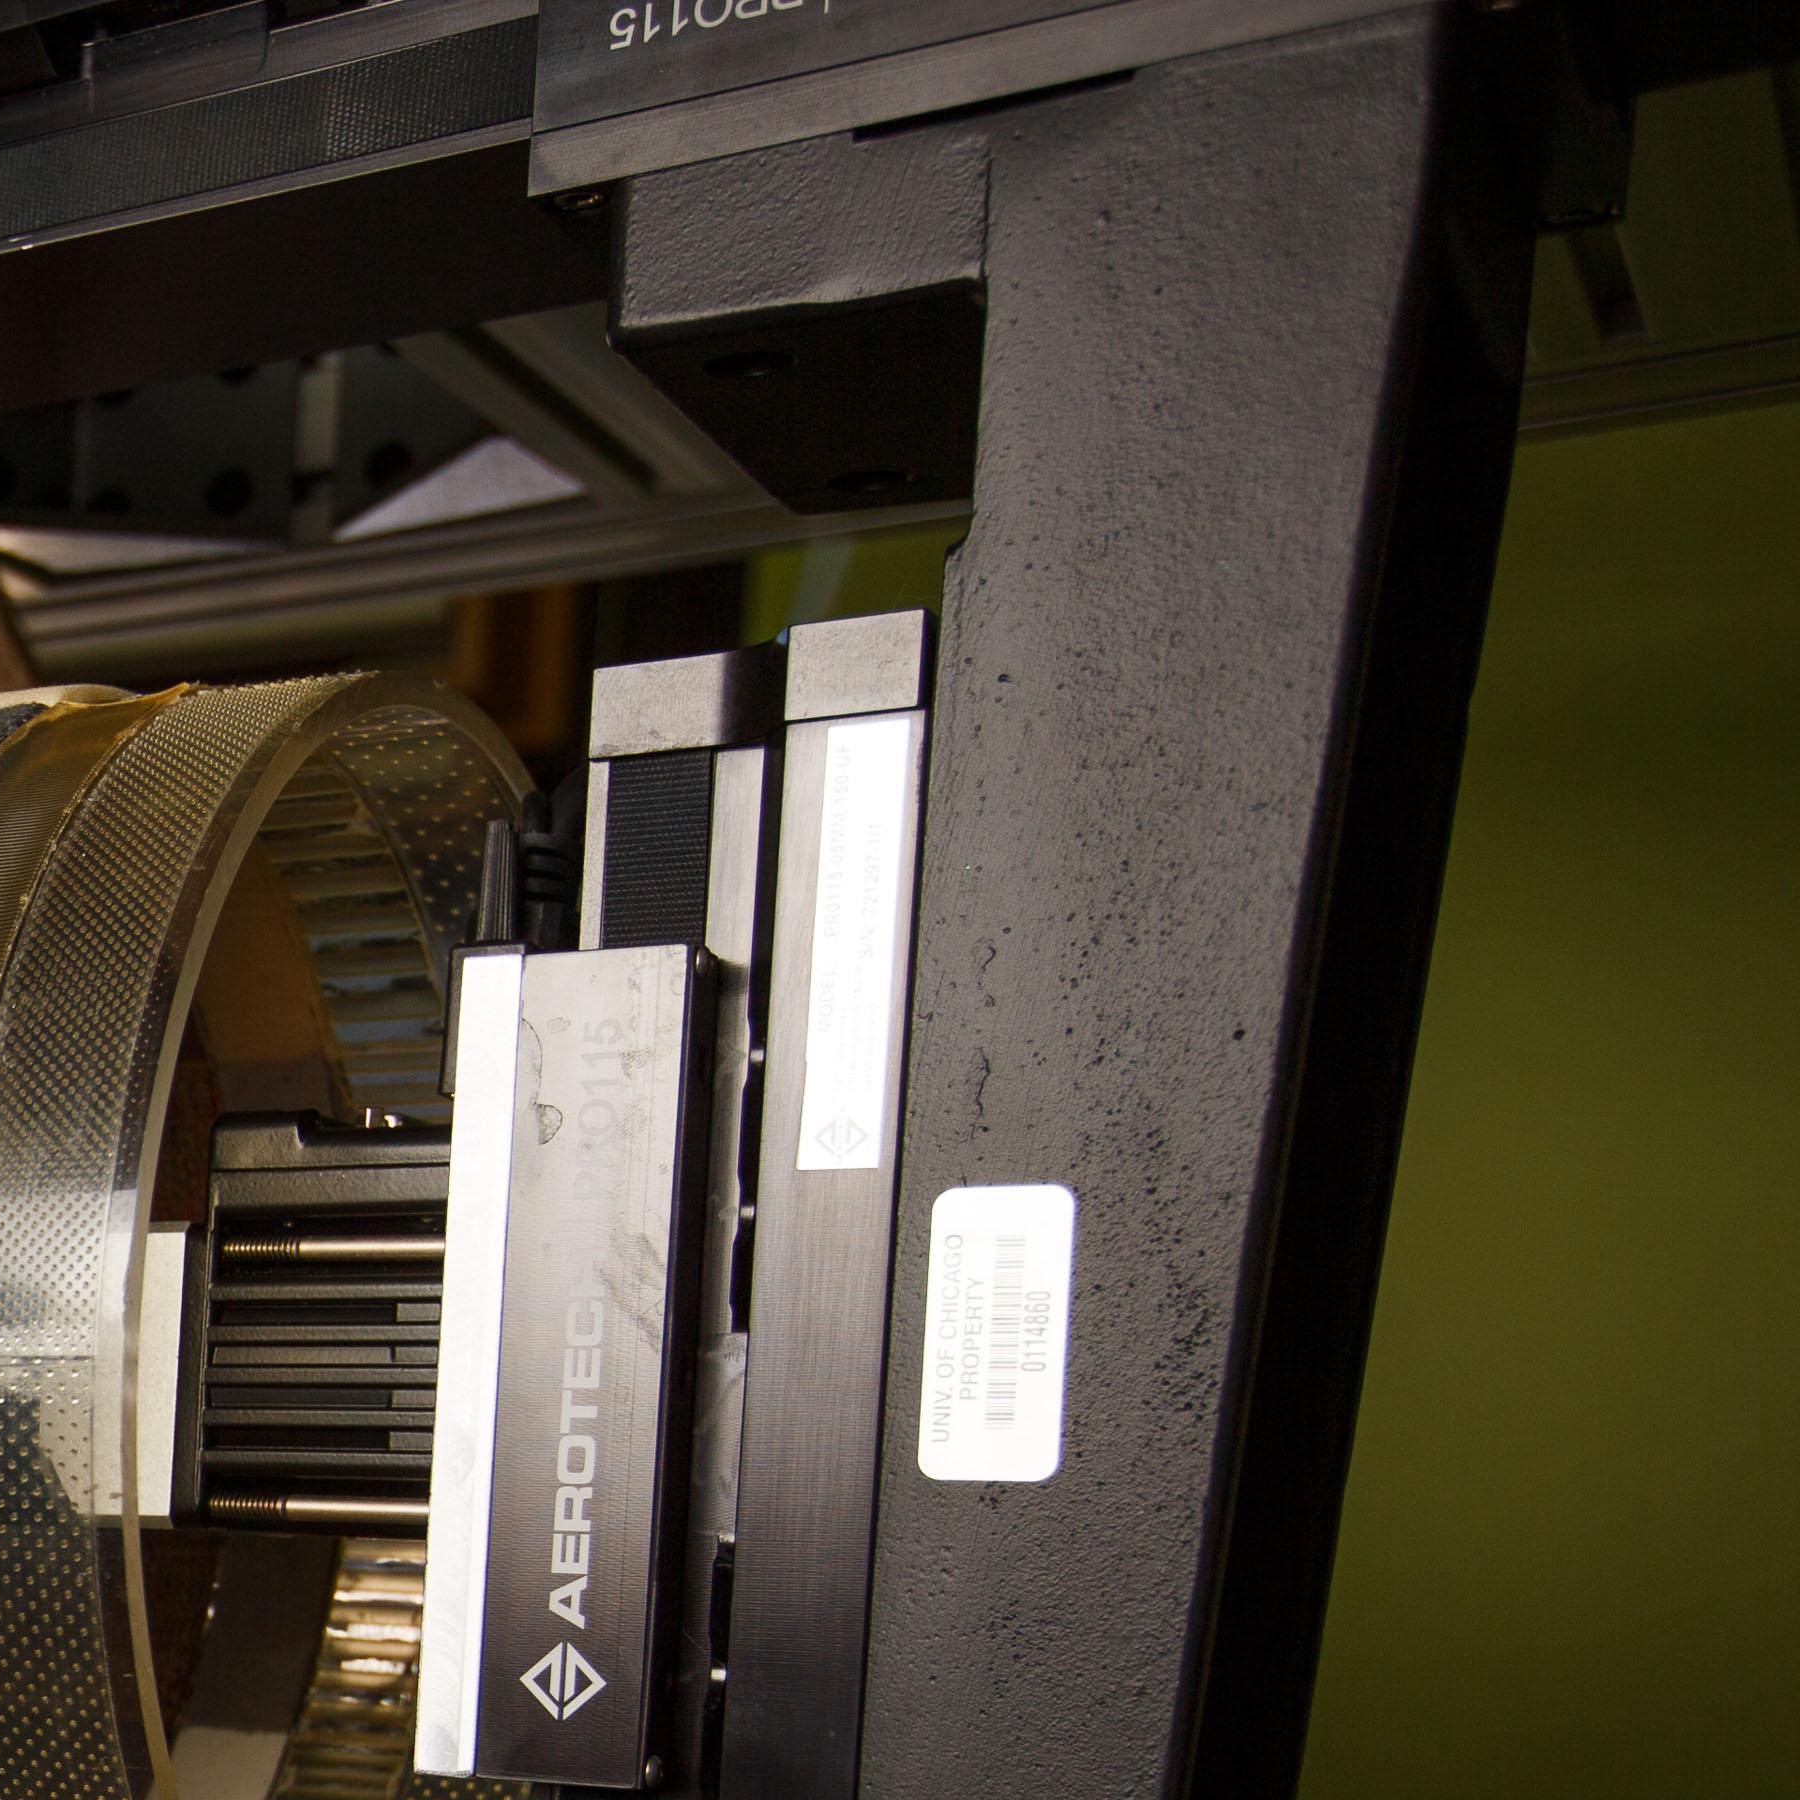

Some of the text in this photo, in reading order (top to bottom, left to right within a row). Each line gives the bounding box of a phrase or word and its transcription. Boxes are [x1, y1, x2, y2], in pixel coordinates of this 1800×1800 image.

[931, 1233, 965, 1444] UNIV. OF CHICAGO
[959, 1274, 985, 1401] PROPERTY
[1020, 1290, 1051, 1373] 0114860
[548, 1246, 607, 1631] AEROTECH
